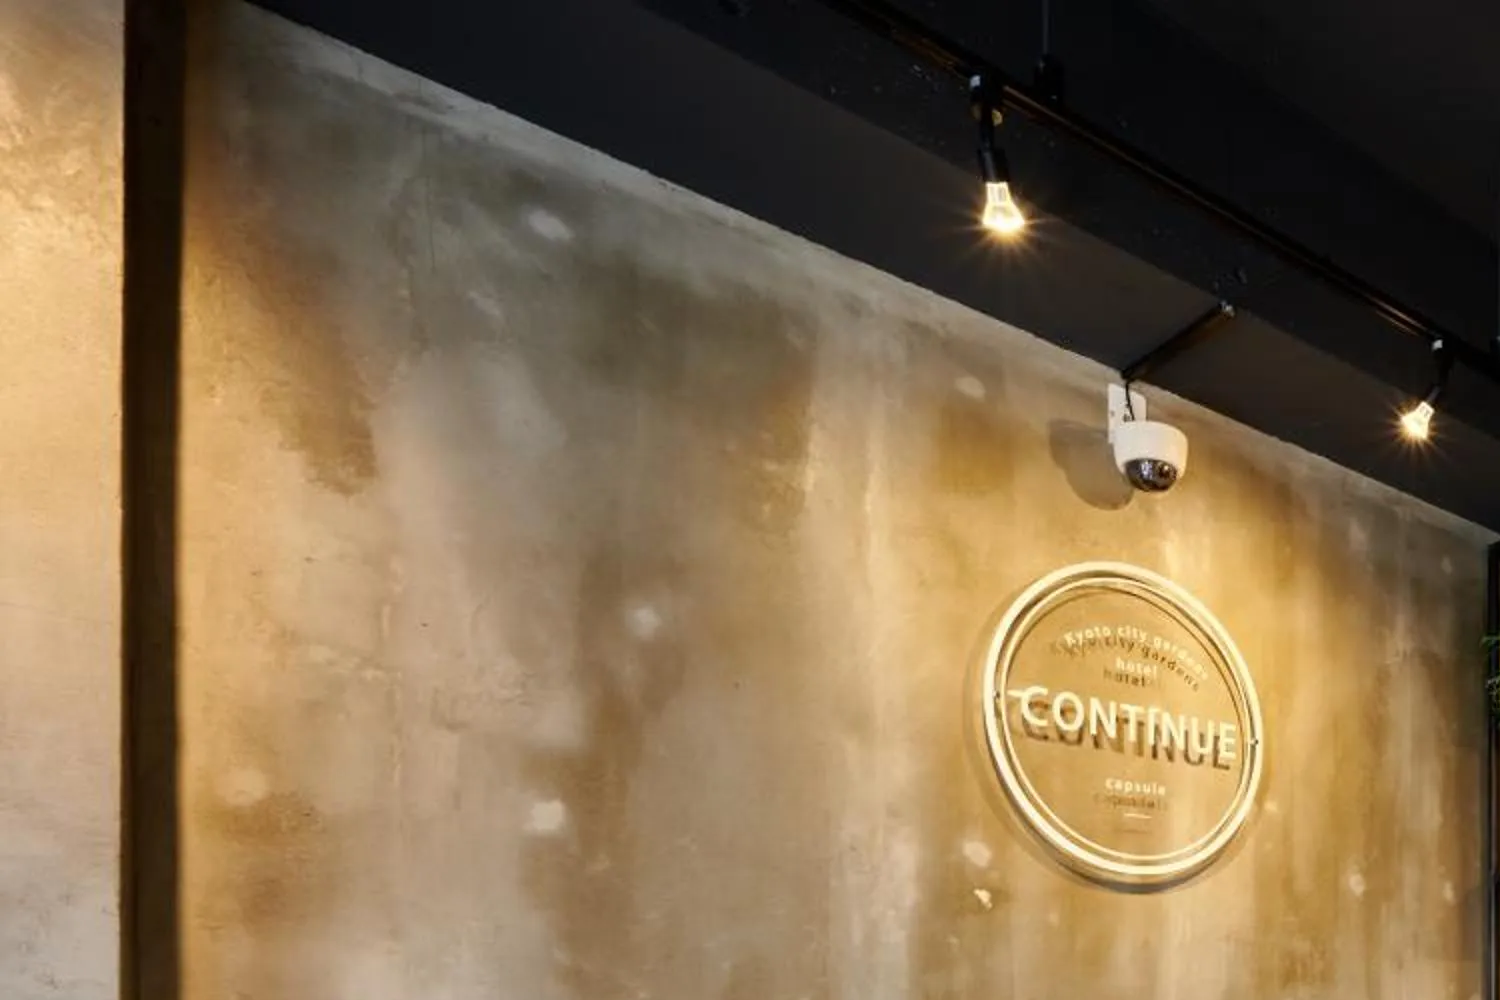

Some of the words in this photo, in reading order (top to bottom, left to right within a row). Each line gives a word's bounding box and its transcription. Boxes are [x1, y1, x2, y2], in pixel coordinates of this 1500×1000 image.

[1064, 626, 1112, 648] Kyoto
[1117, 625, 1148, 643] city
[1115, 656, 1158, 678] hotel
[1008, 686, 1237, 759] CONTINUE
[1105, 778, 1166, 796] capsule
